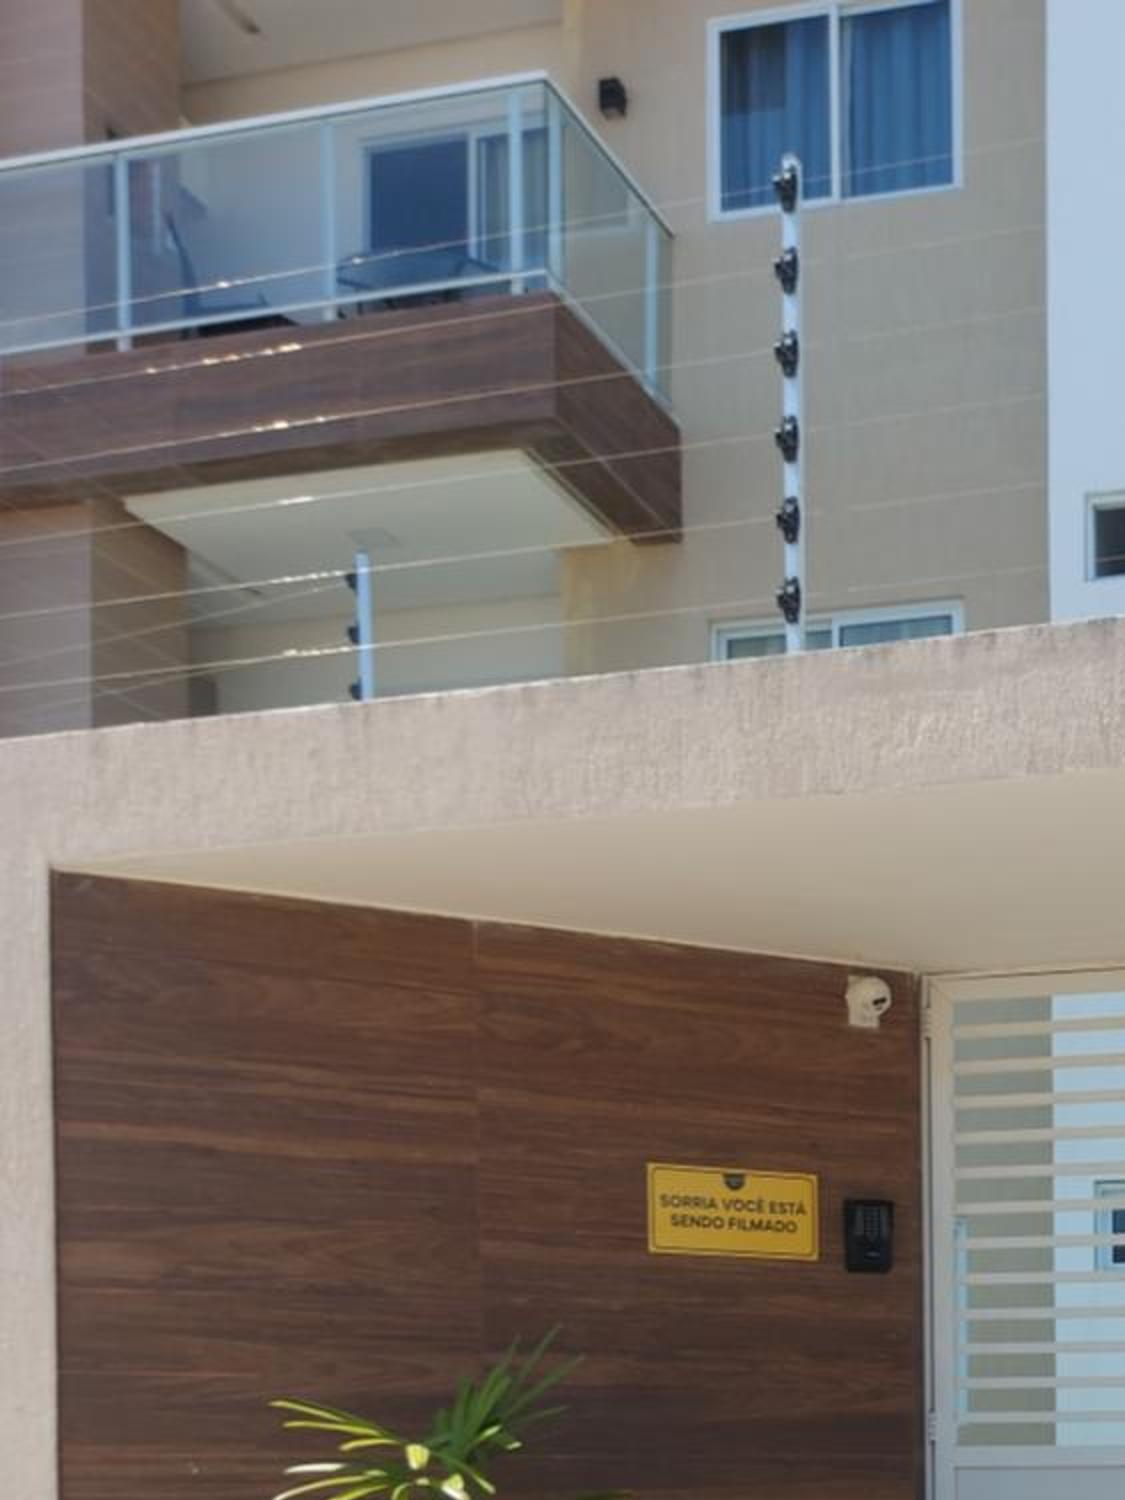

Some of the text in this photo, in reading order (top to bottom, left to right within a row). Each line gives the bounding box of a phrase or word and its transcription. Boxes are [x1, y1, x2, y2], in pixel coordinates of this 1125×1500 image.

[660, 1193, 718, 1211] SORRIA
[721, 1195, 764, 1214] VOCÊ
[671, 1213, 798, 1234] SENDO FILMADO
